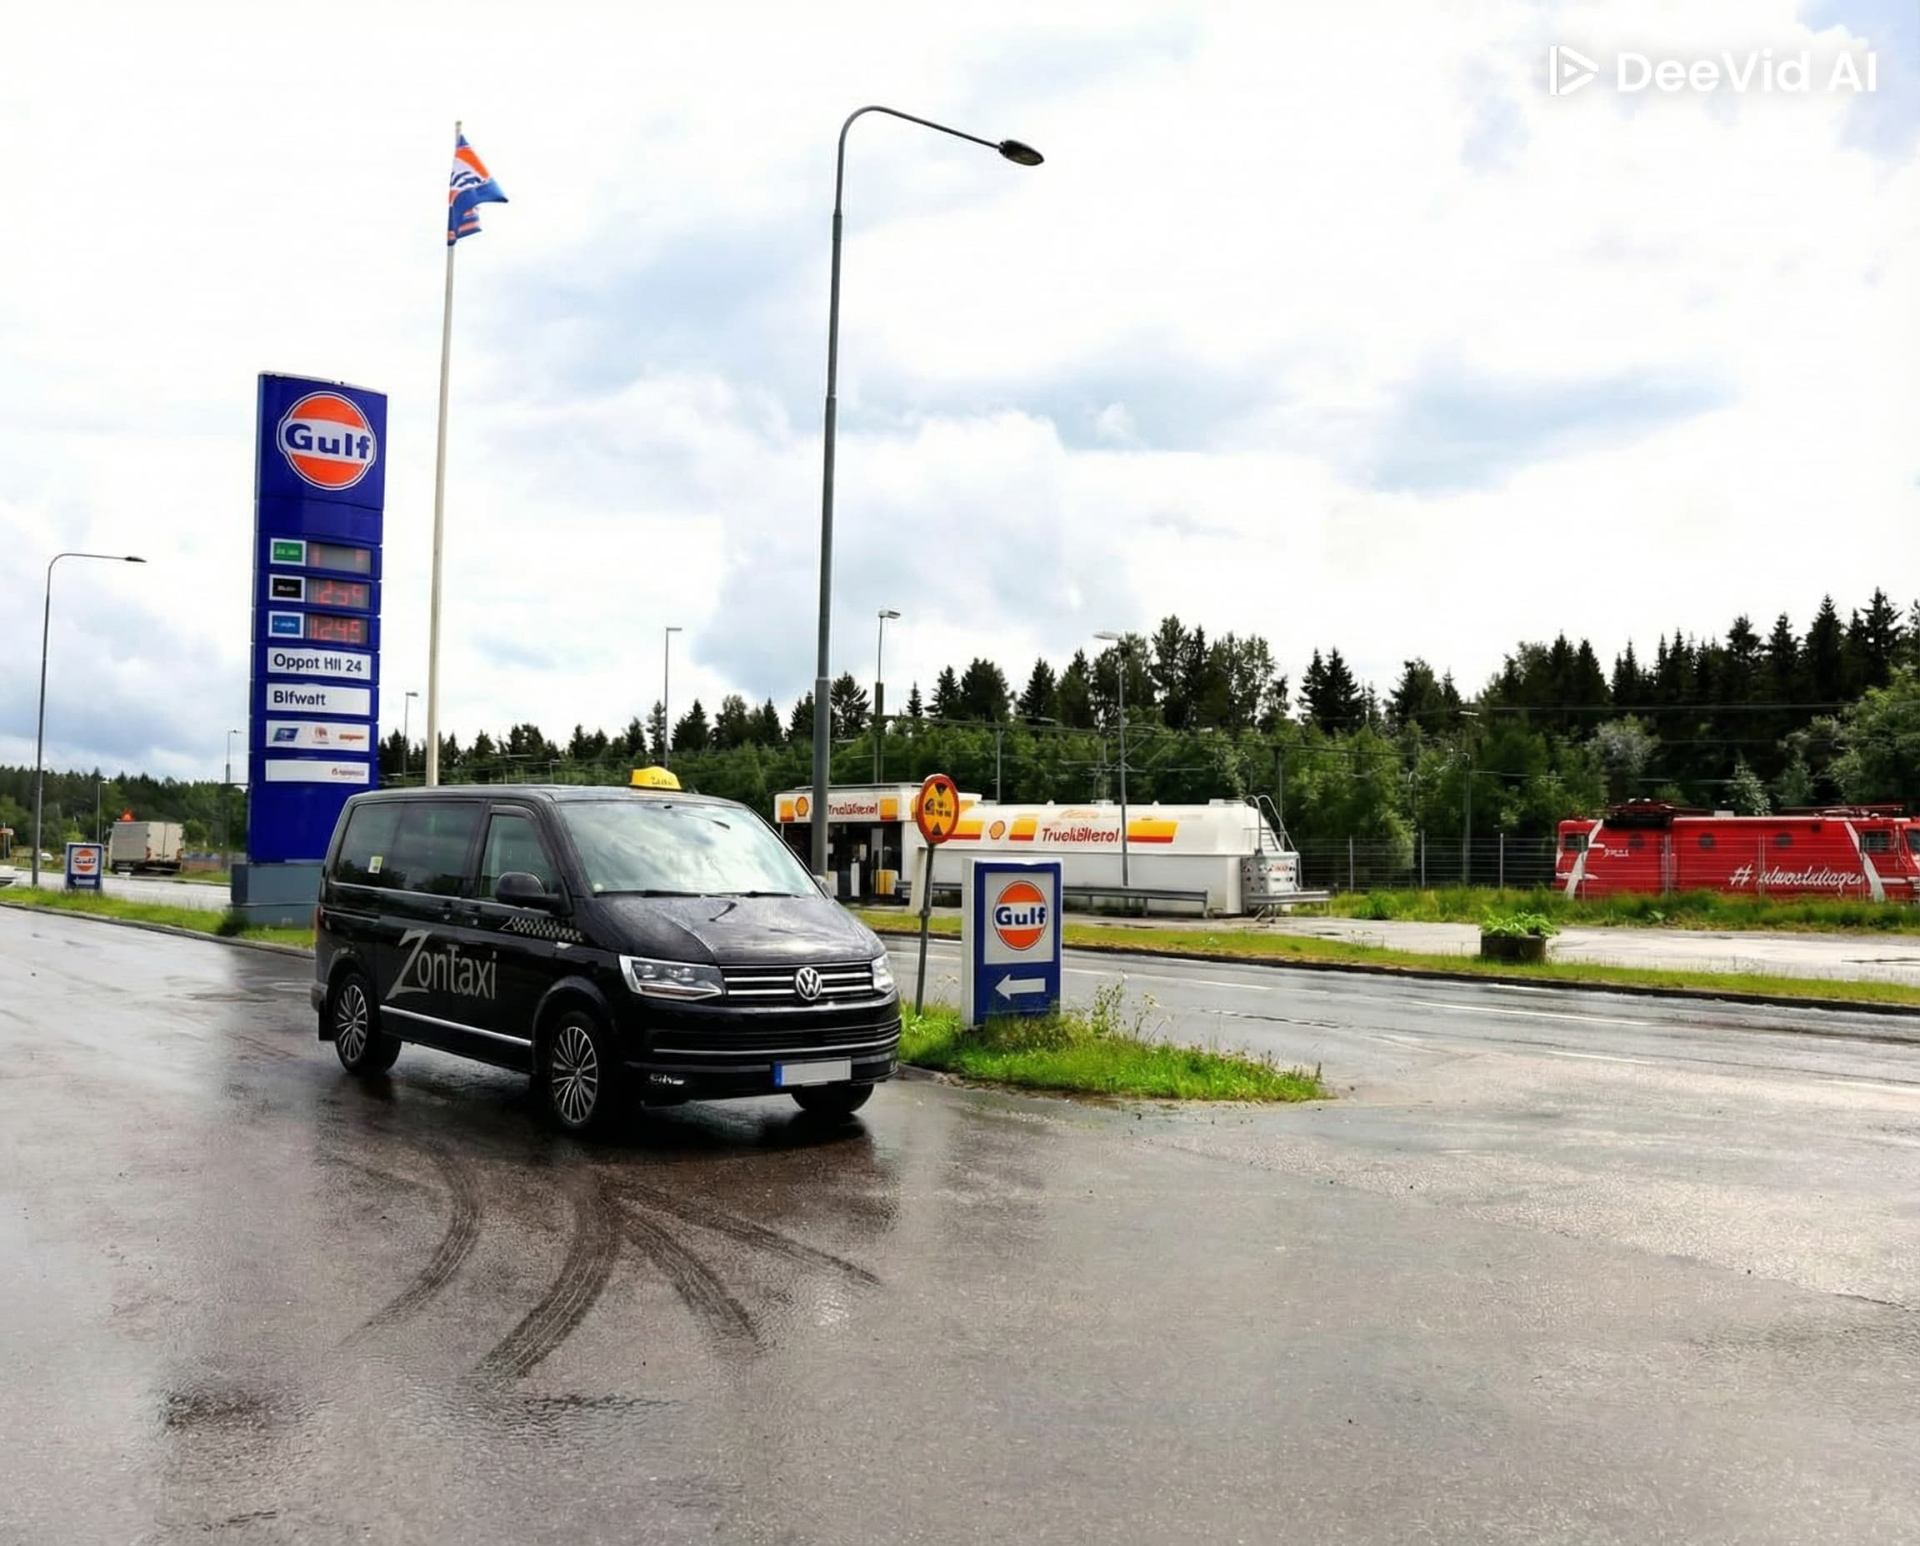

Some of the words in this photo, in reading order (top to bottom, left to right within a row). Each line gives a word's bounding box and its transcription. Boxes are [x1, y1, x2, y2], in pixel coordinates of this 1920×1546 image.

[285, 423, 371, 460] Gulf
[346, 659, 362, 672] 24
[995, 906, 1046, 926] Gulf
